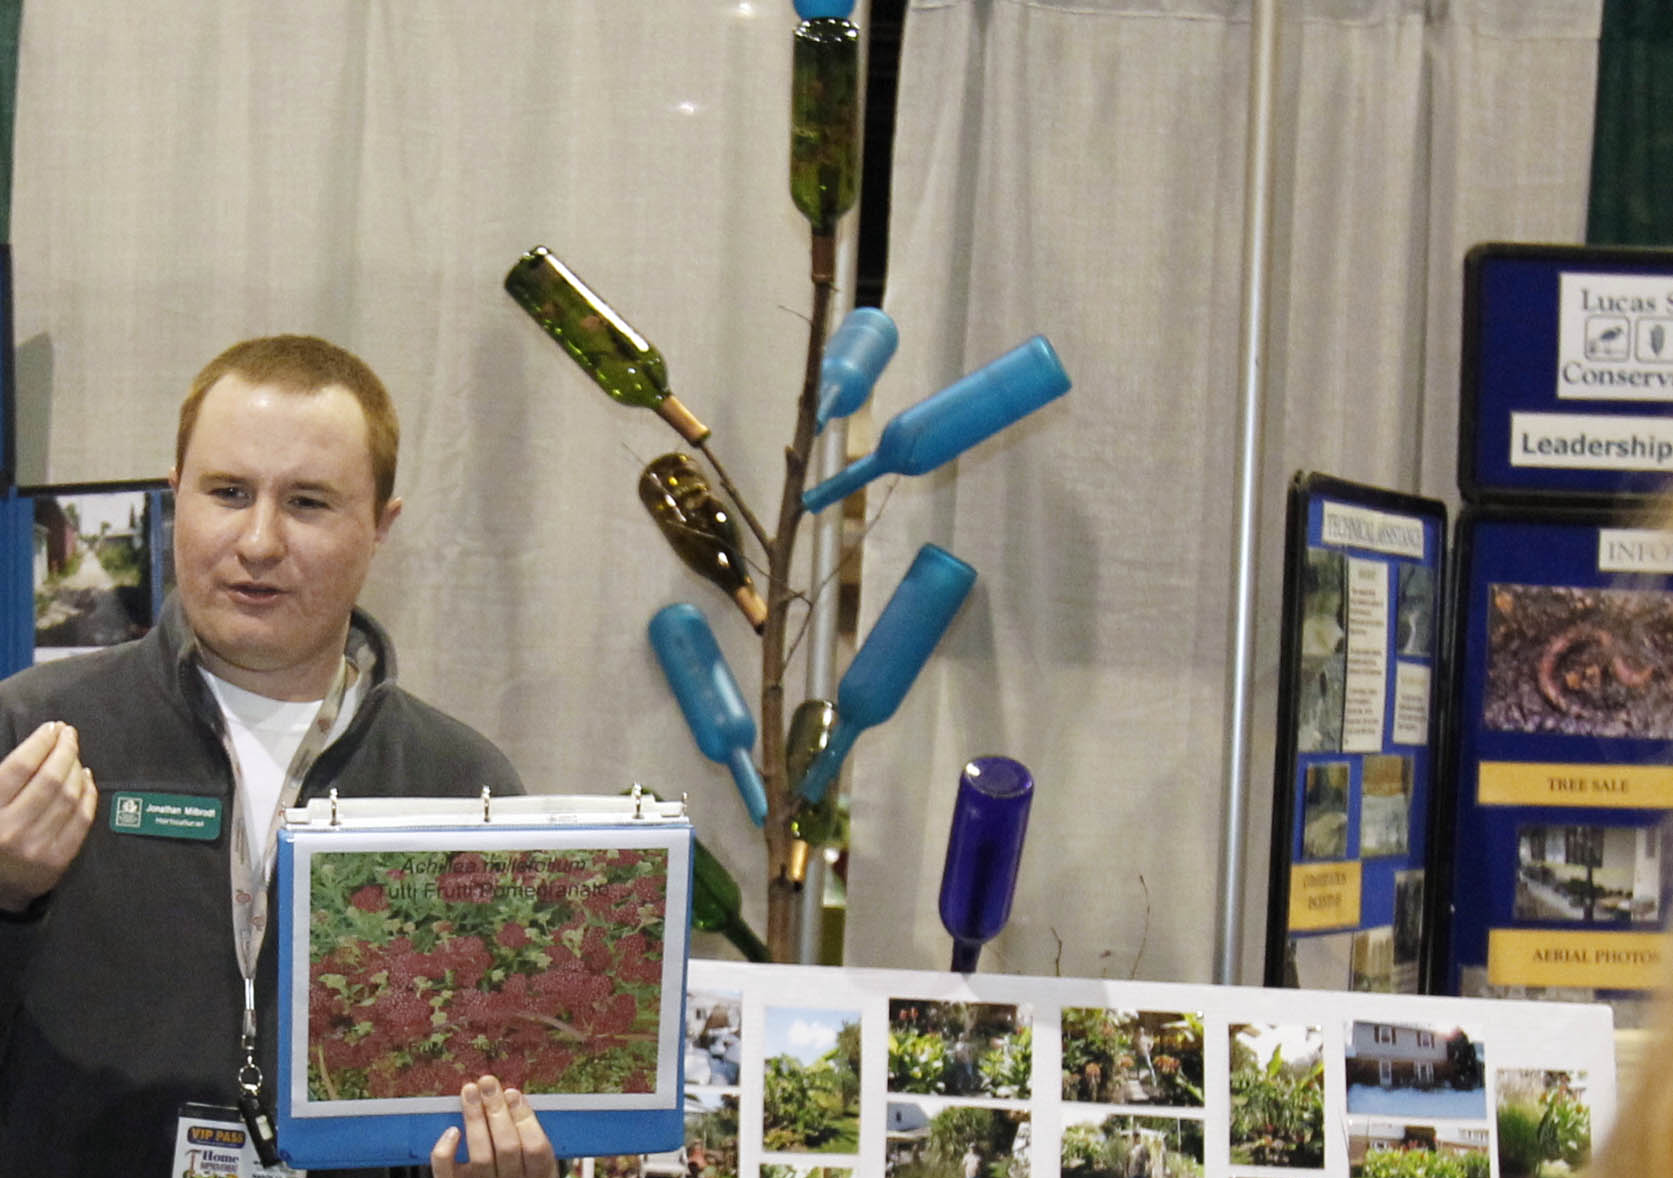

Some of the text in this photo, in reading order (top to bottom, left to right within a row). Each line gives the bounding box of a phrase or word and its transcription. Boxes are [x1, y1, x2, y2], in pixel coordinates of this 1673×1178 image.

[1580, 288, 1658, 313] Lucas
[1562, 361, 1673, 387] Conserv
[1521, 433, 1673, 462] Leadership
[1547, 778, 1629, 794] TREE SALE
[400, 857, 477, 874] Achillea
[424, 882, 473, 900] Frutti
[1532, 949, 1590, 963] AERIAL
[191, 1127, 246, 1143] VIP PASS
[202, 1149, 240, 1163] Home
